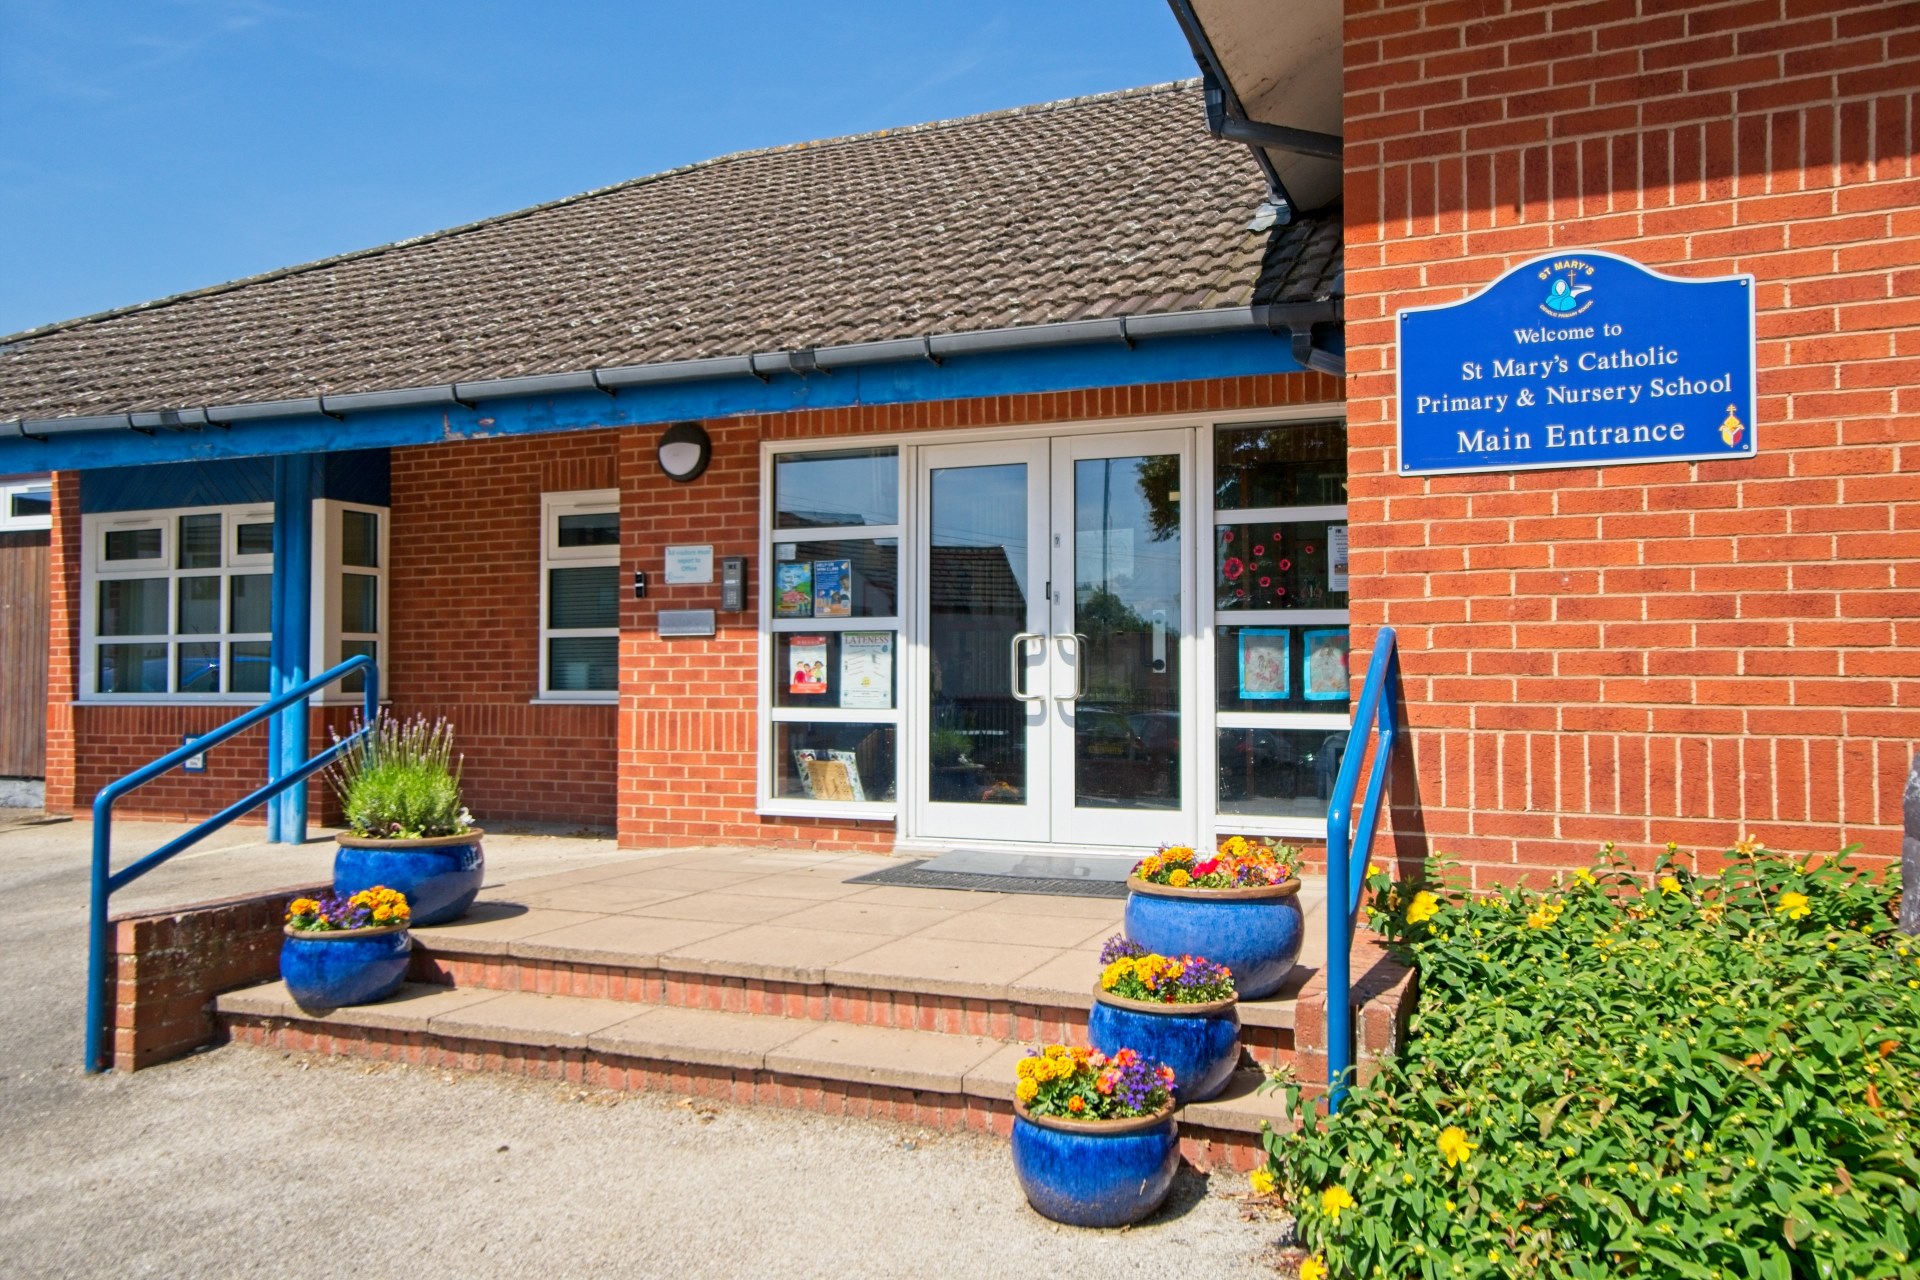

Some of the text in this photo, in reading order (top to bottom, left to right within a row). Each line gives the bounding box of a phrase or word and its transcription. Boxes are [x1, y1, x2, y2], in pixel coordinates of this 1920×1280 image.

[1538, 260, 1595, 280] ST MARY'S
[1513, 323, 1622, 344] Welcome to
[1462, 346, 1678, 380] St Mary's Catholic
[1416, 372, 1732, 414] Primary & Nursery School
[1456, 423, 1685, 453] Main Entrance
[845, 635, 890, 645] LATENESS
